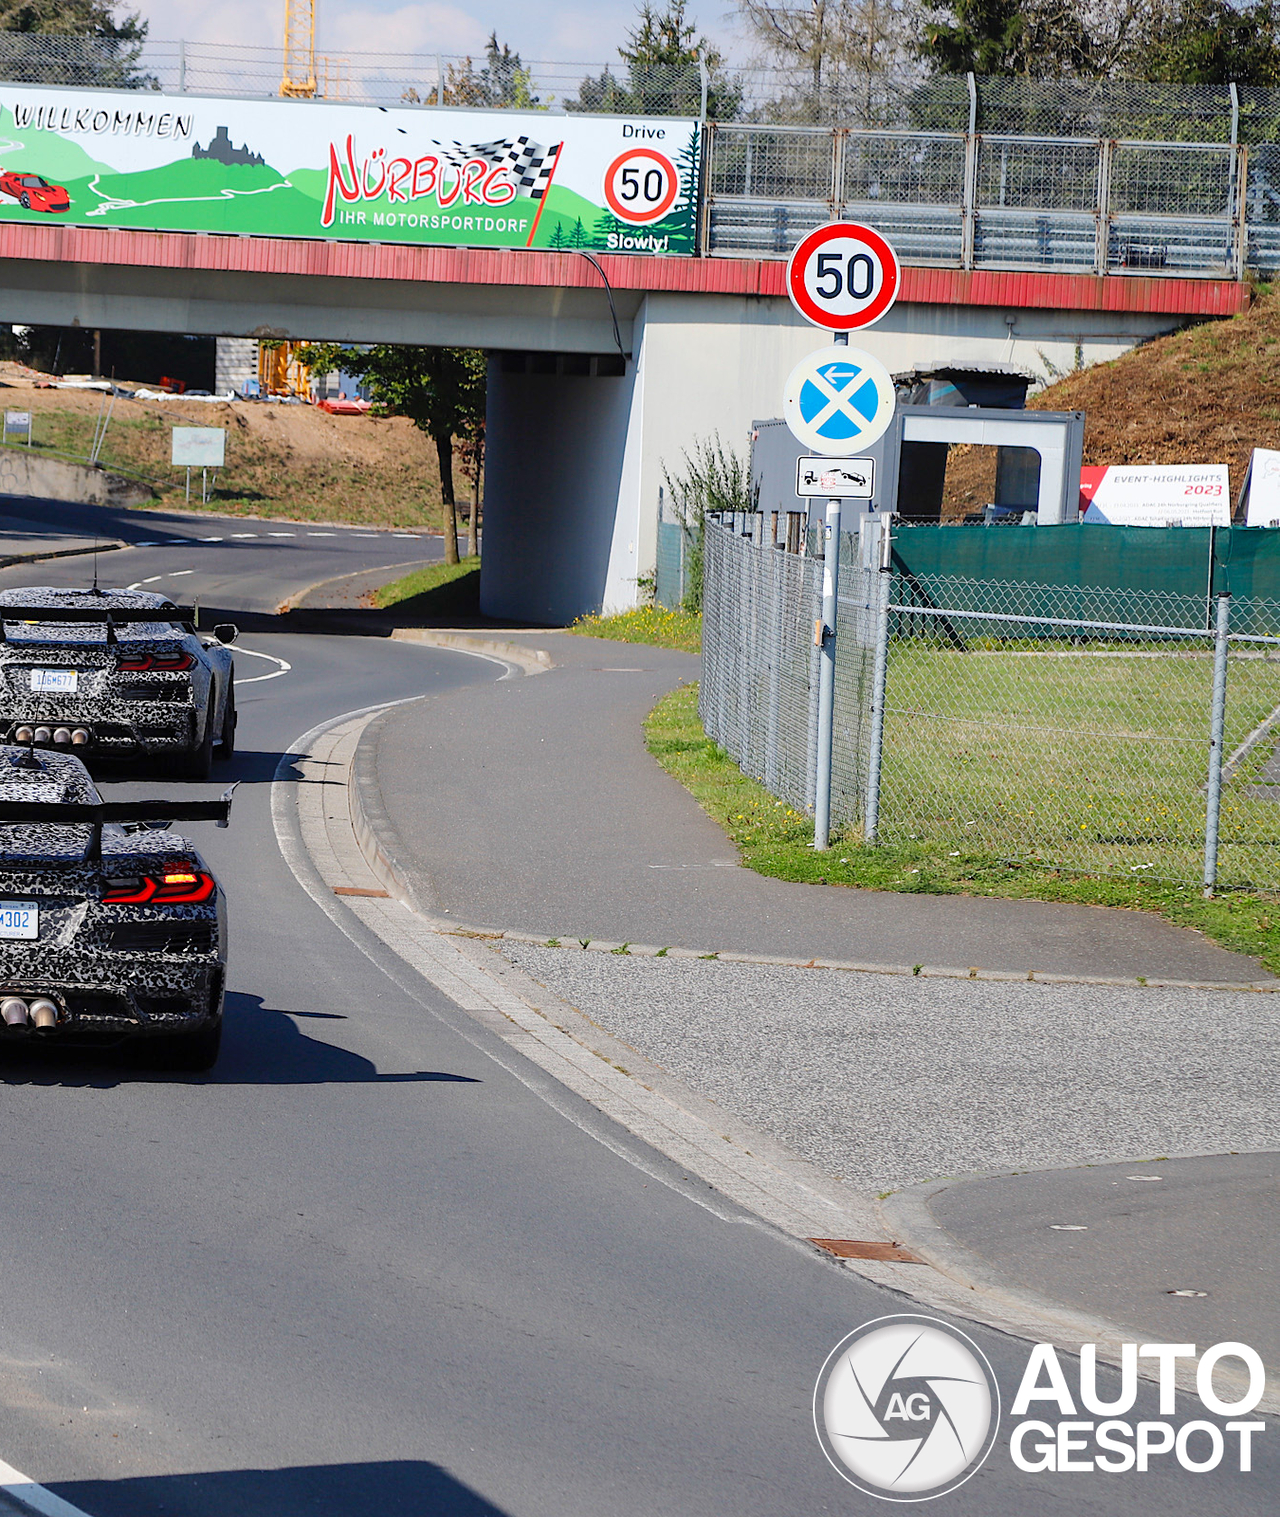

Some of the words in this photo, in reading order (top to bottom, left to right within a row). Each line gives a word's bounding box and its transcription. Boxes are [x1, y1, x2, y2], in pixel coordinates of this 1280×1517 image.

[14, 103, 192, 138] WILLKOMMEN
[622, 124, 666, 139] Drive
[322, 133, 515, 225] NÜRBURG
[620, 168, 663, 201] 50
[340, 210, 367, 225] IHR
[373, 212, 528, 232] MOTORSPORTDORF
[606, 232, 669, 254] Slowly!
[816, 253, 874, 300] 50
[1114, 474, 1222, 483] EVENT-HIGHLIGHTS
[1184, 484, 1223, 497] 2023
